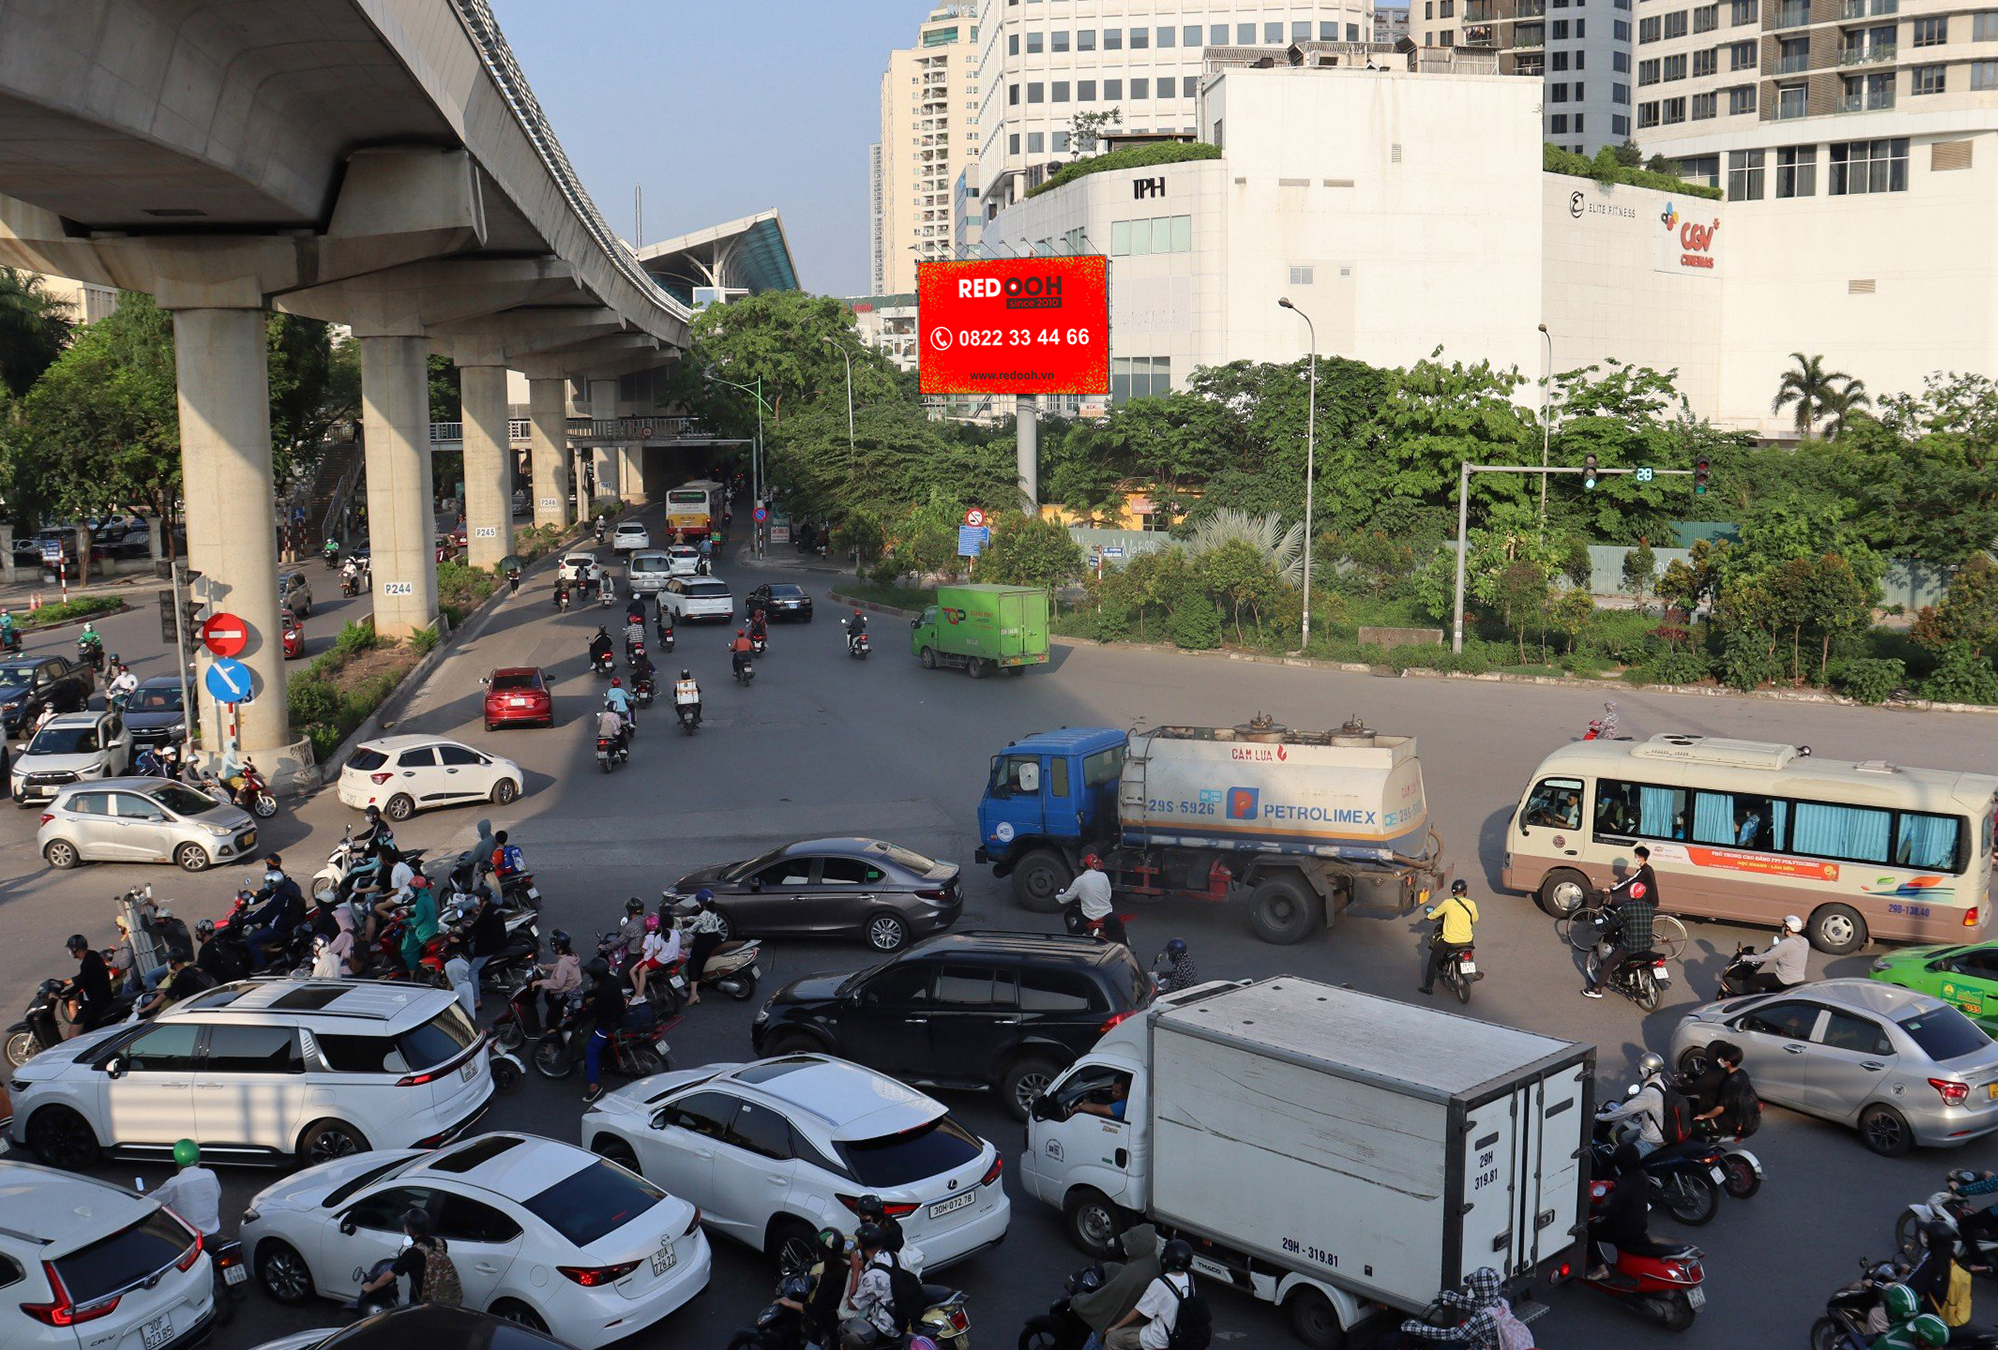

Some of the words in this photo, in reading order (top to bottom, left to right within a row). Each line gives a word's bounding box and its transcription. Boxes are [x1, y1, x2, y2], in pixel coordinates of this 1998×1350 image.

[1588, 203, 1606, 215] ELITE
[1607, 205, 1636, 218] FITNESS
[1680, 222, 1714, 252] CGV
[1681, 254, 1714, 269] CINEMAS
[958, 278, 1001, 298] RED
[1004, 276, 1062, 297] OOH
[1009, 298, 1035, 308] since
[1036, 298, 1059, 307] 2010
[959, 330, 1003, 346] 0822
[1009, 329, 1031, 346] 33
[1037, 329, 1060, 345] 44
[1066, 328, 1090, 345] 66
[970, 370, 1055, 380] www.redooh.vn
[1637, 468, 1653, 481] 28
[476, 528, 495, 537] P245
[385, 584, 411, 594] P244
[1148, 799, 1215, 815] 29S-5926
[1264, 803, 1377, 824] PETROLIMEX
[1479, 1150, 1494, 1169] 29H
[1474, 1168, 1498, 1191] 319.81
[933, 1193, 972, 1215] 30H-072.78
[1282, 1237, 1299, 1254] 29H
[1308, 1246, 1338, 1268] 319.81
